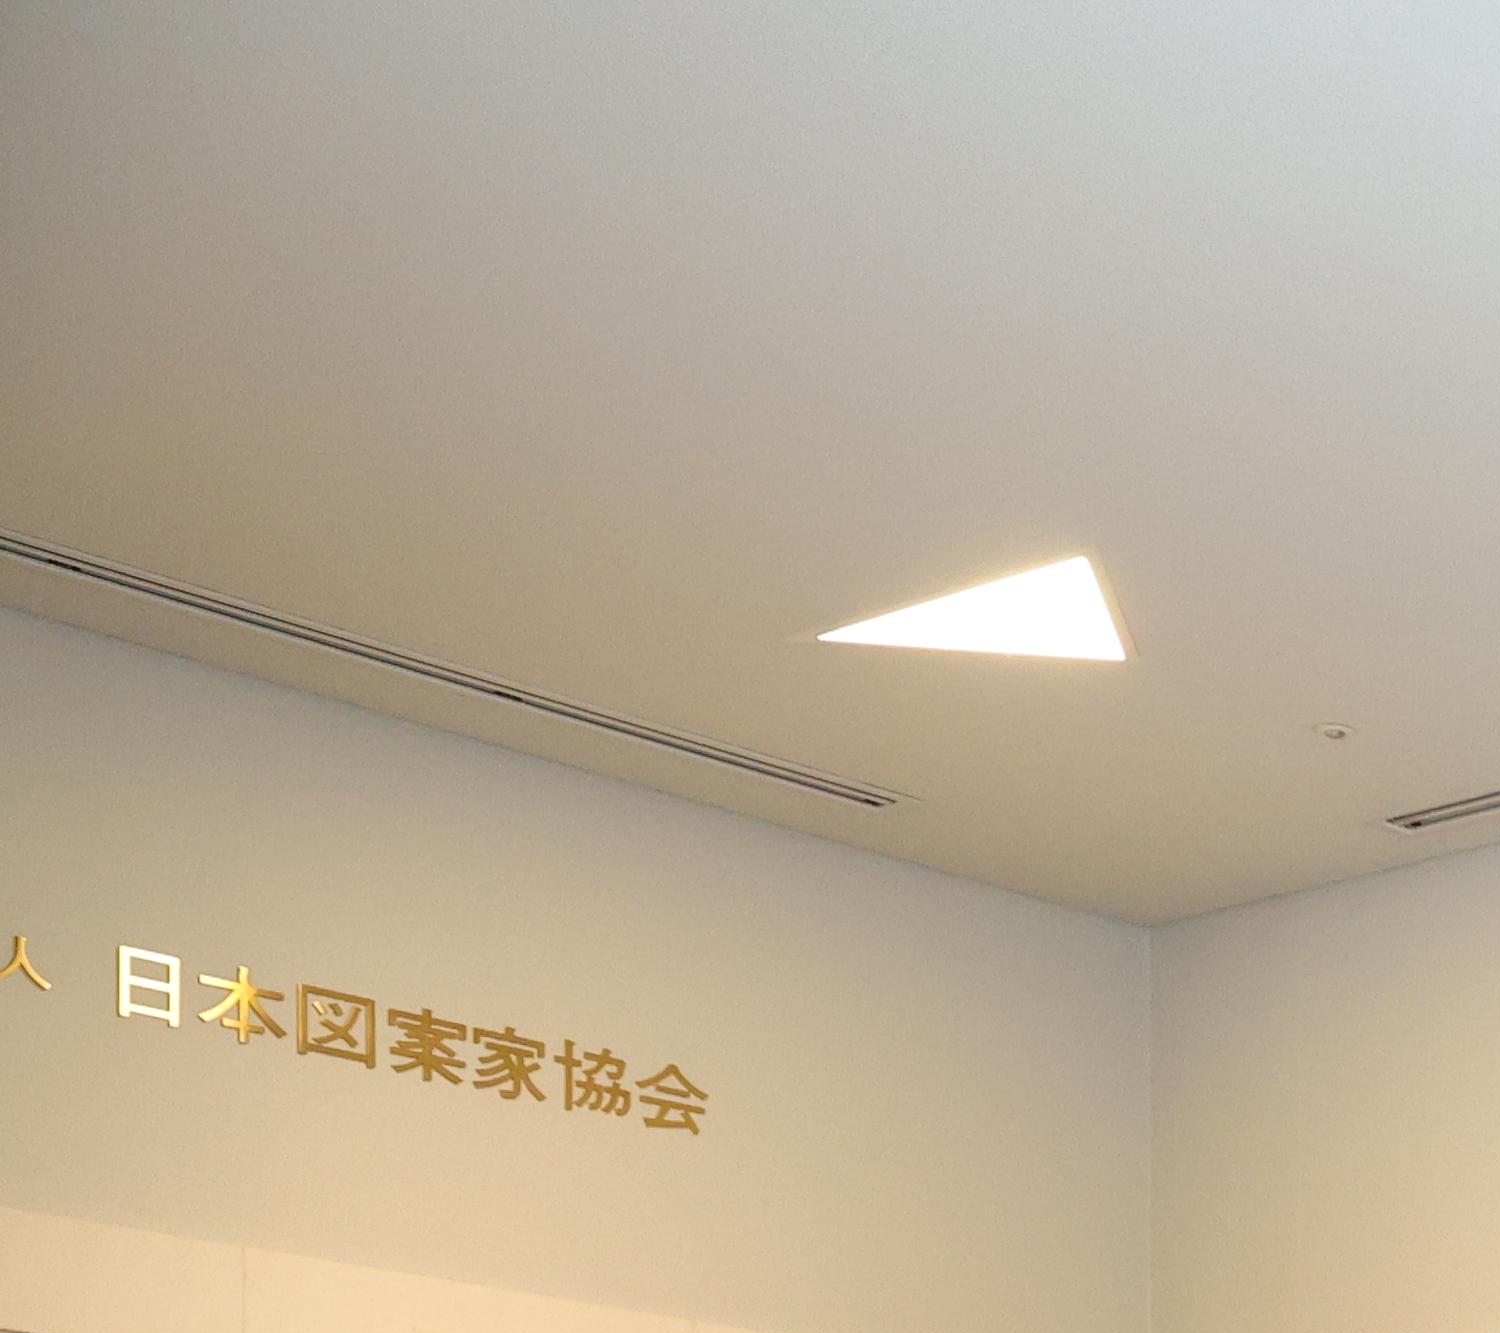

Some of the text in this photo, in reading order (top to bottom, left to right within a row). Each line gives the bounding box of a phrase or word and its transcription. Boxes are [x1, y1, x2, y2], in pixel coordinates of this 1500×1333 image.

[116, 944, 709, 1136] 日本図案家協会
